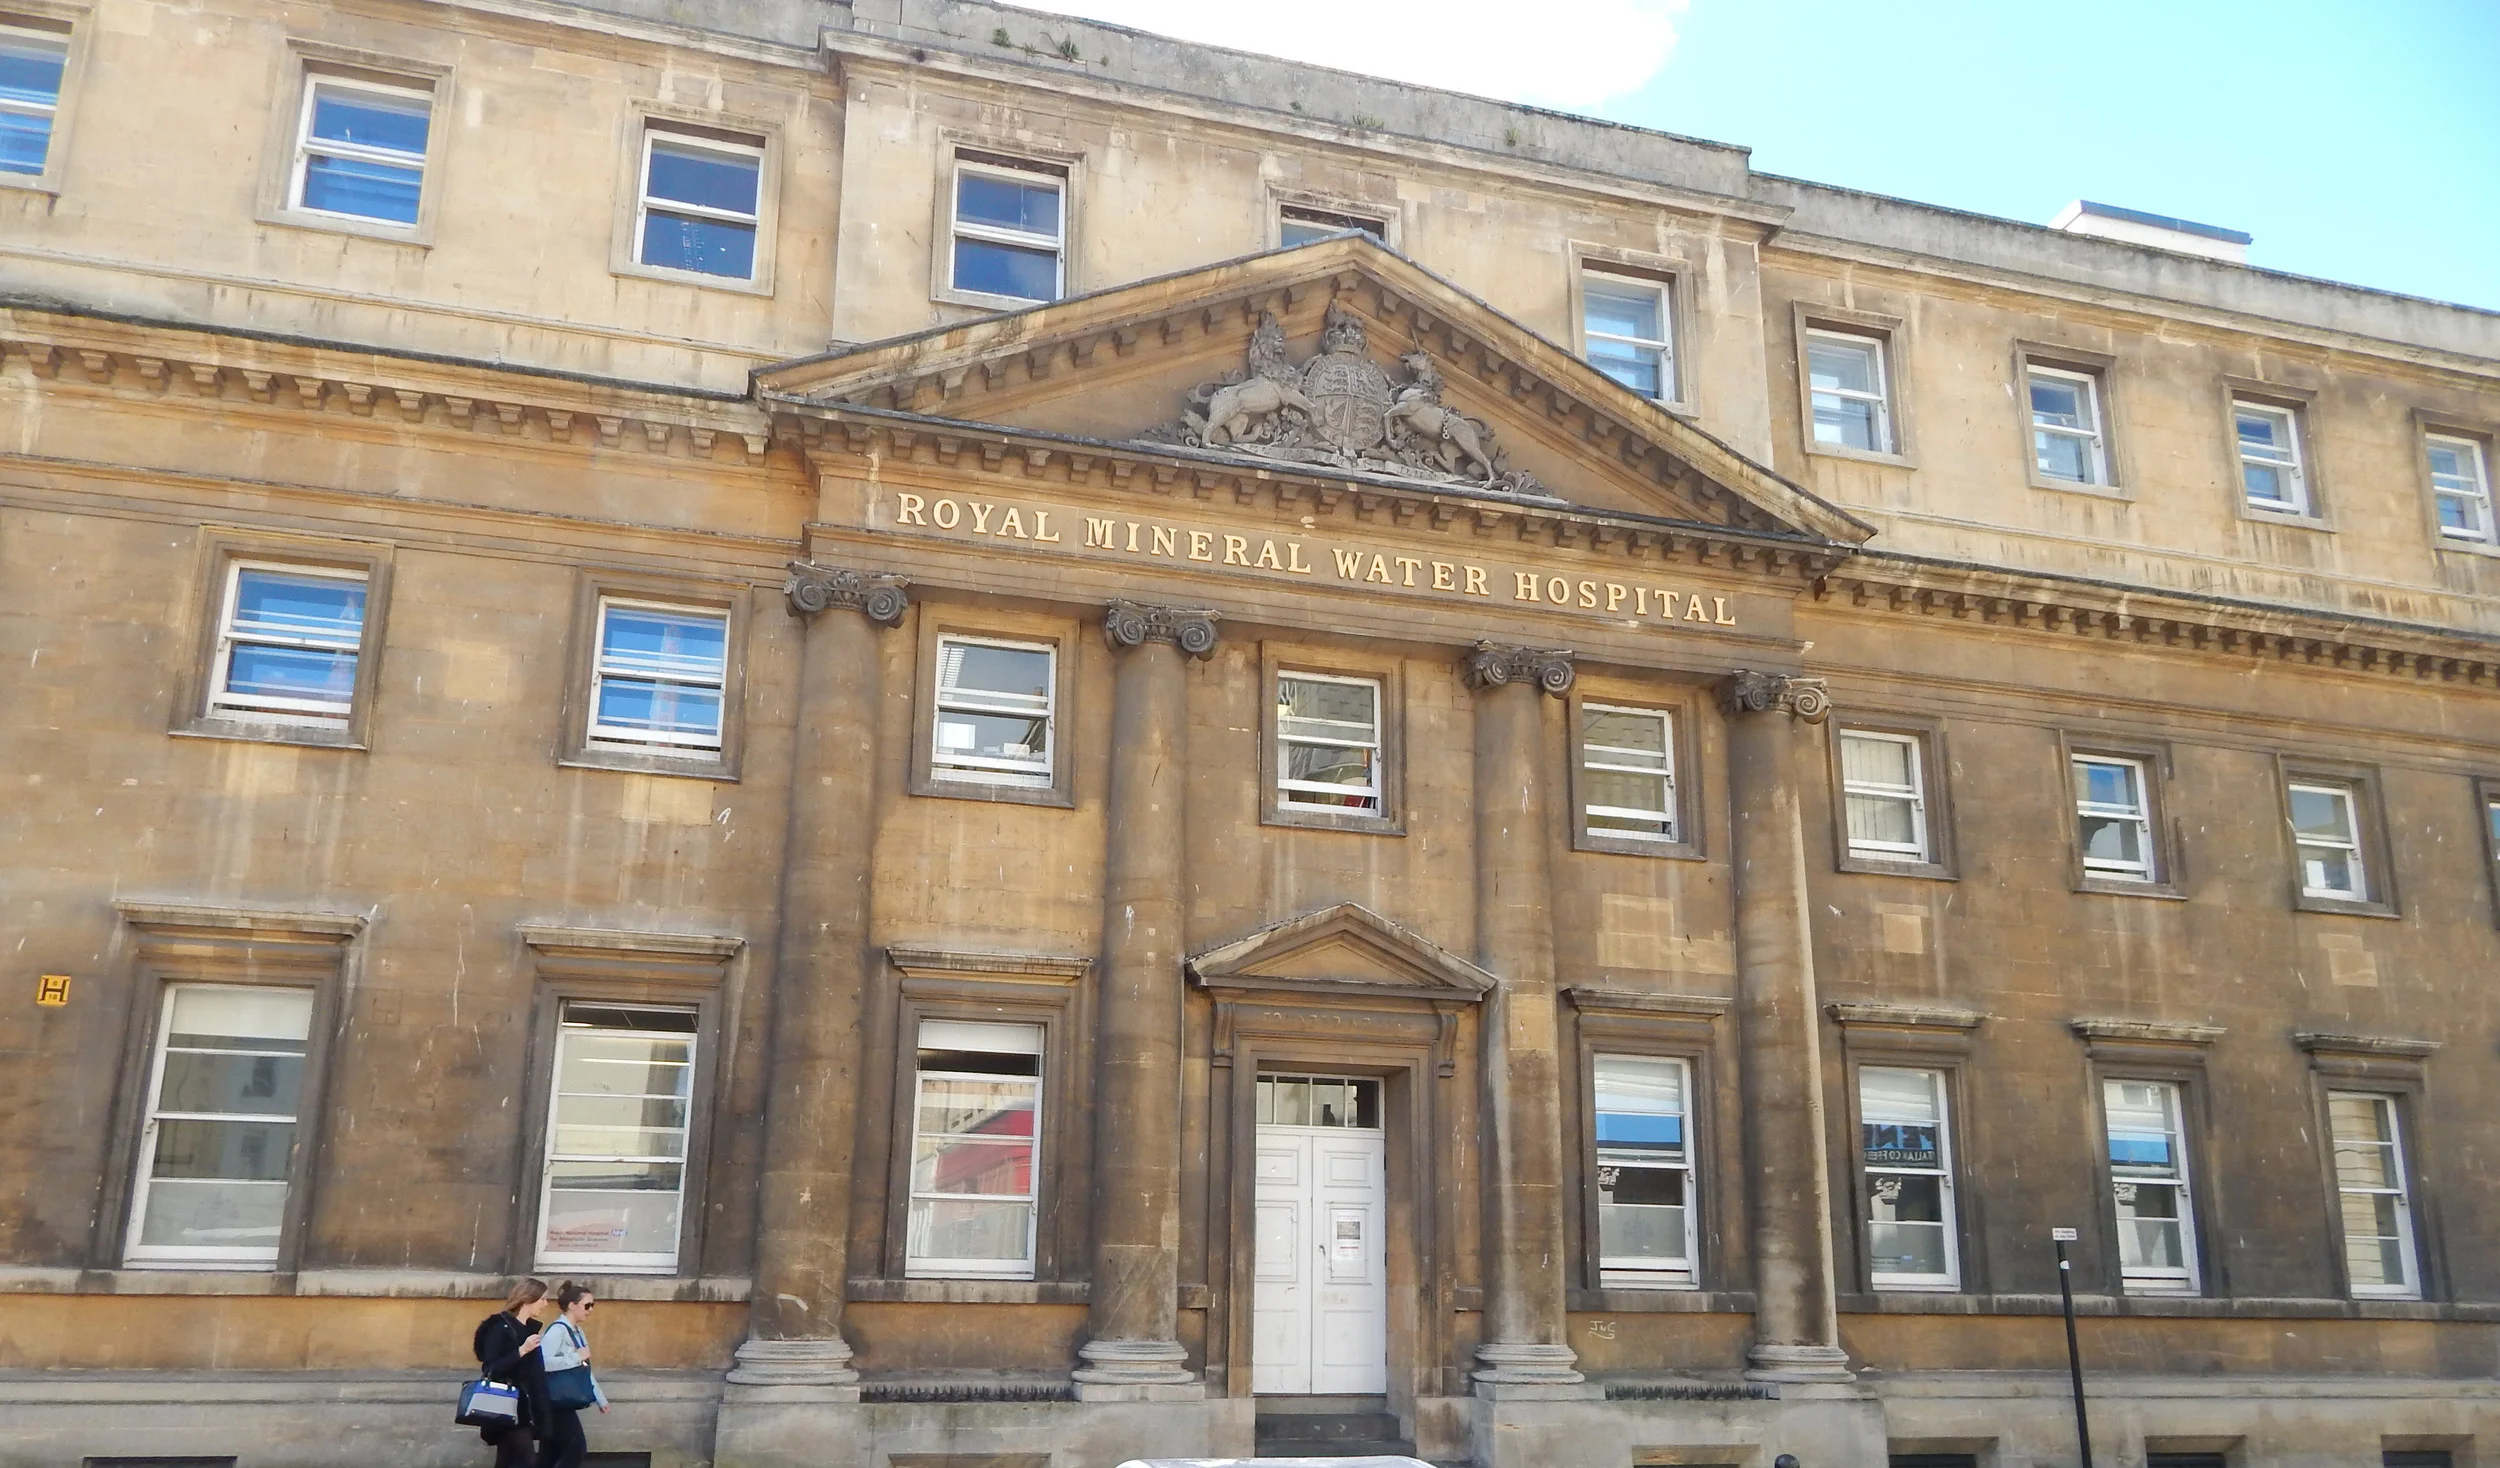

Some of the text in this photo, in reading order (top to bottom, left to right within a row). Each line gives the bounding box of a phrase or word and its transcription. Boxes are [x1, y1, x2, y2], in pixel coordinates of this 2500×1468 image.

[896, 492, 1737, 626] ROYAL MINERAL WATER HOSPITAL
[38, 977, 70, 1002] H
